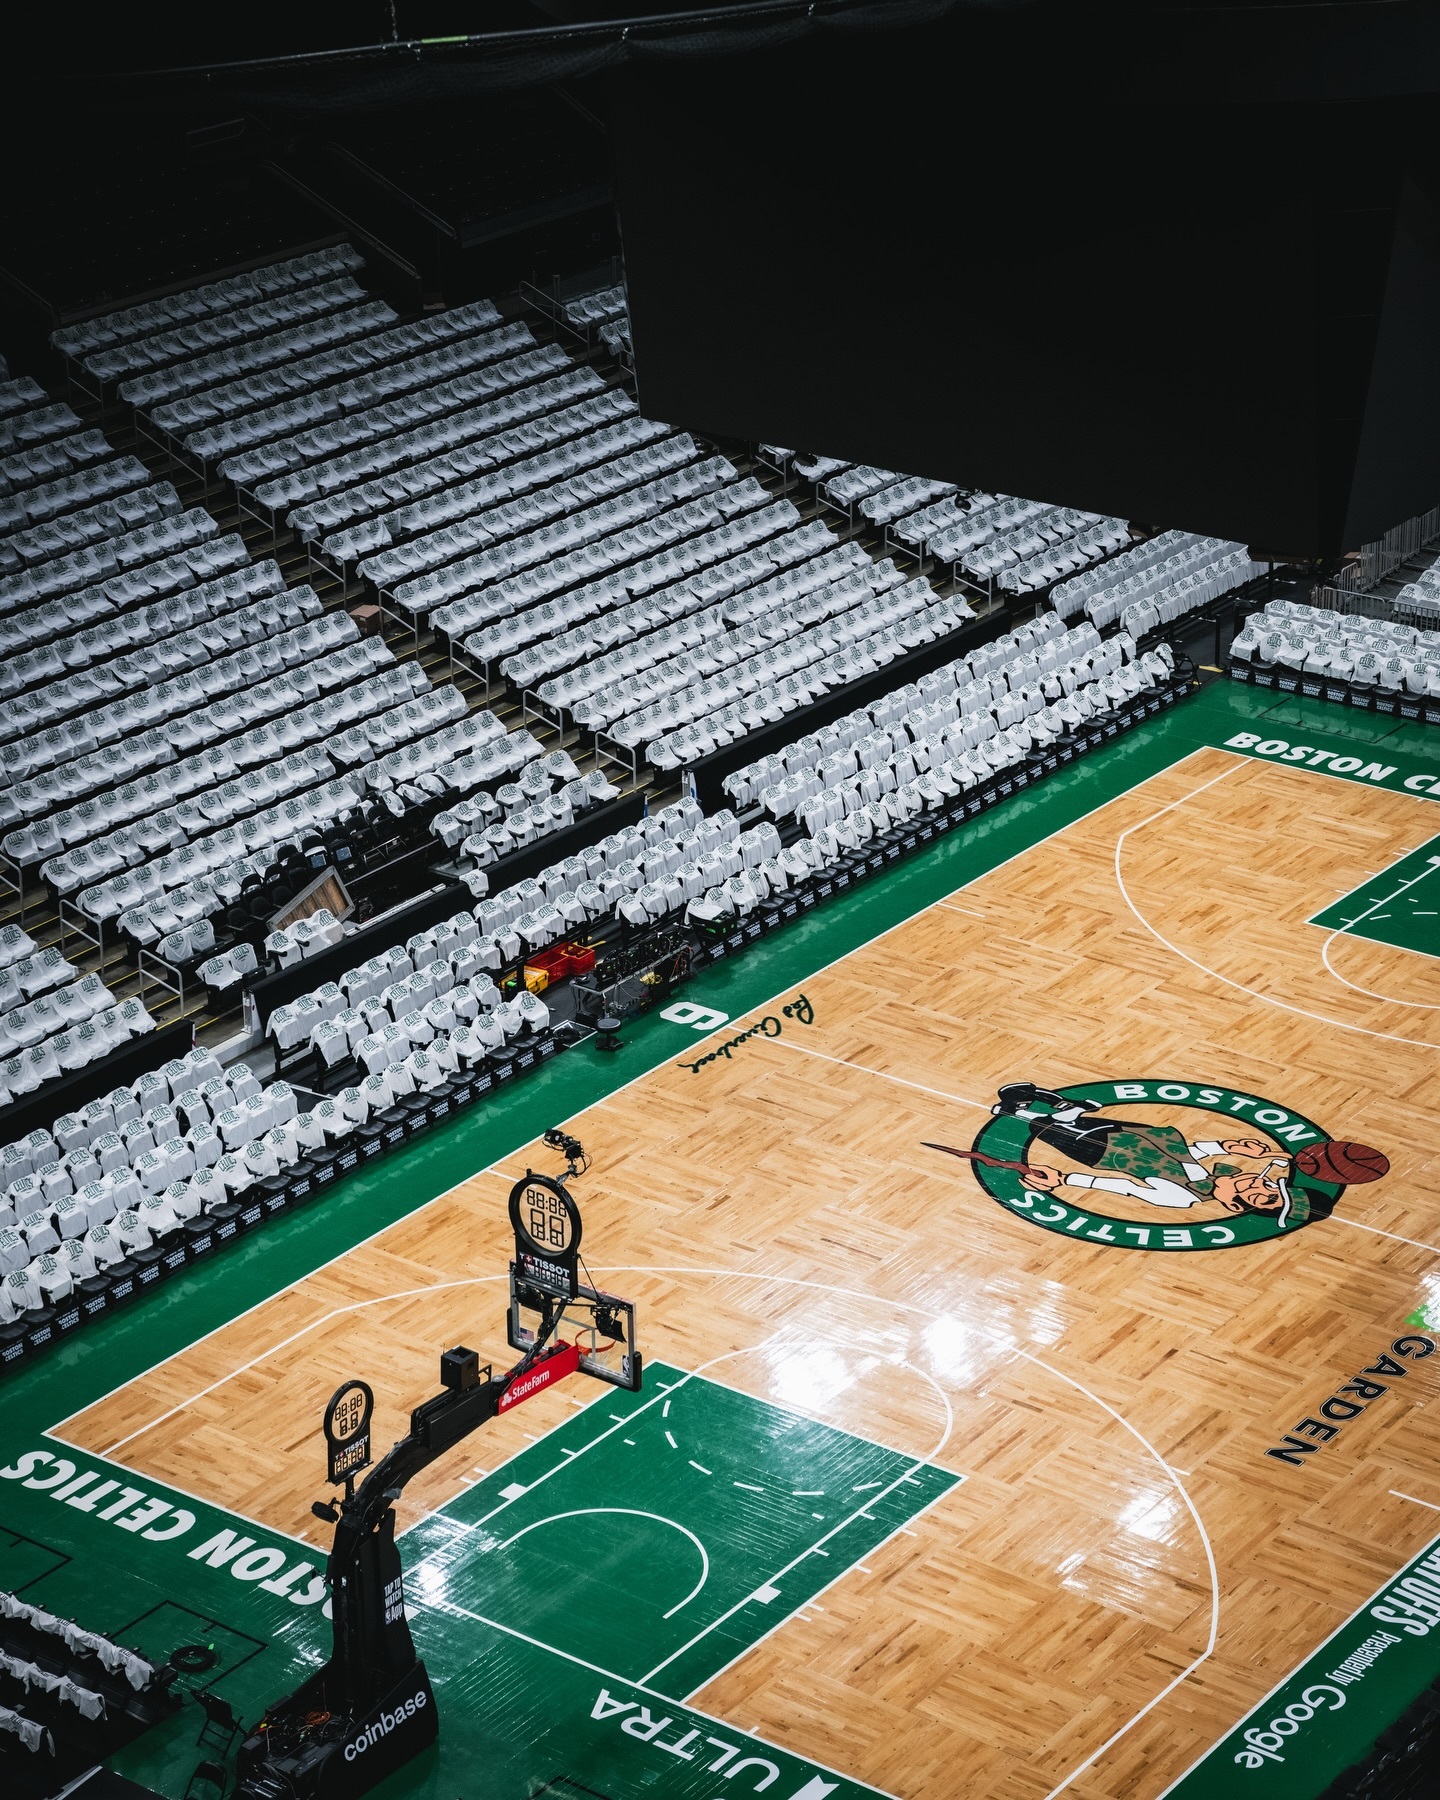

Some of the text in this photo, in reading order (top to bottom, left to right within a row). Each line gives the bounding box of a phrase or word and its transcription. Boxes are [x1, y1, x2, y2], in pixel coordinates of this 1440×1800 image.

[1223, 732, 1398, 781] BOSTON
[1113, 1084, 1317, 1142] BOSTON
[1009, 1191, 1235, 1247] CELTICS
[533, 1256, 570, 1277] TISSOT
[1264, 1335, 1435, 1467] GARDEN
[344, 1435, 369, 1455] TISSOT
[0, 1450, 334, 1620] STON CELTICS
[385, 1588, 402, 1608] WATCH
[391, 1603, 403, 1621] App
[1325, 1630, 1402, 1686] Presented by
[344, 1691, 427, 1761] coinbase
[590, 1689, 780, 1793] ULTRA
[1234, 1684, 1346, 1768] Google
